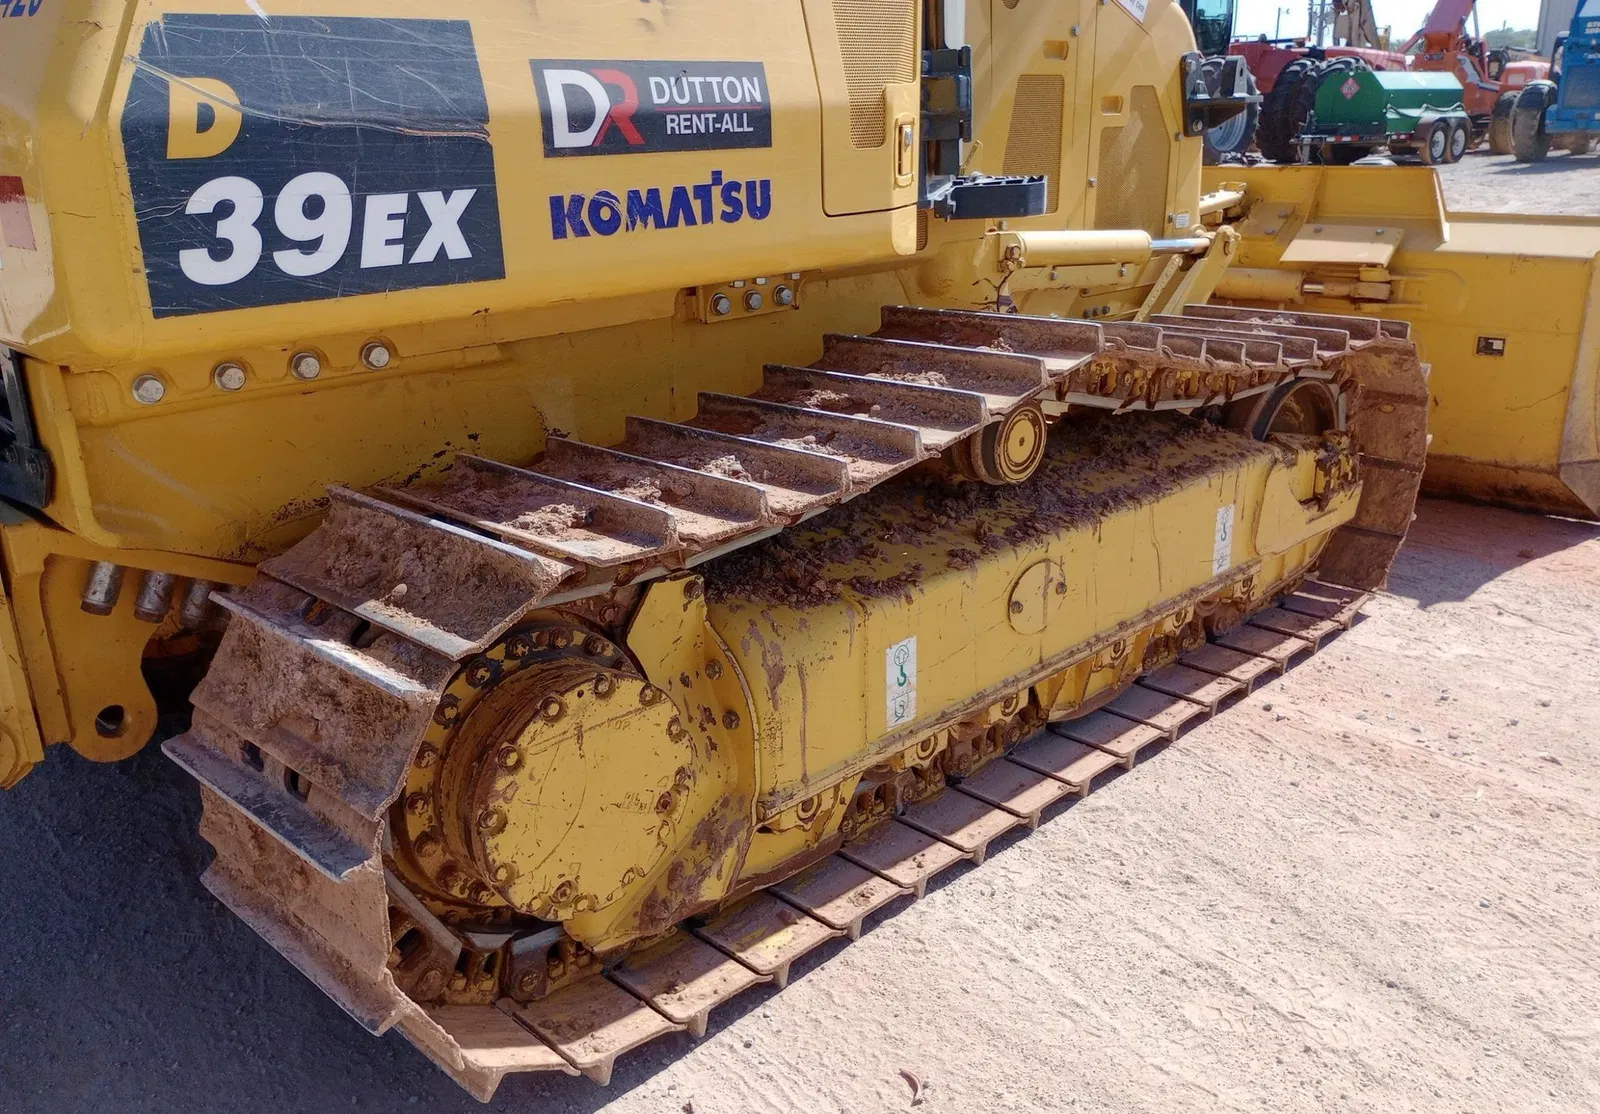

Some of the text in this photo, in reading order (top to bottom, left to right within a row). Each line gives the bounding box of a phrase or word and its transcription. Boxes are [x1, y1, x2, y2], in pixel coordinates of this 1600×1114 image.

[648, 76, 763, 105] DUTTON
[166, 77, 243, 160] D
[665, 112, 754, 135] RENT-ALL
[549, 170, 772, 240] KOMATSU
